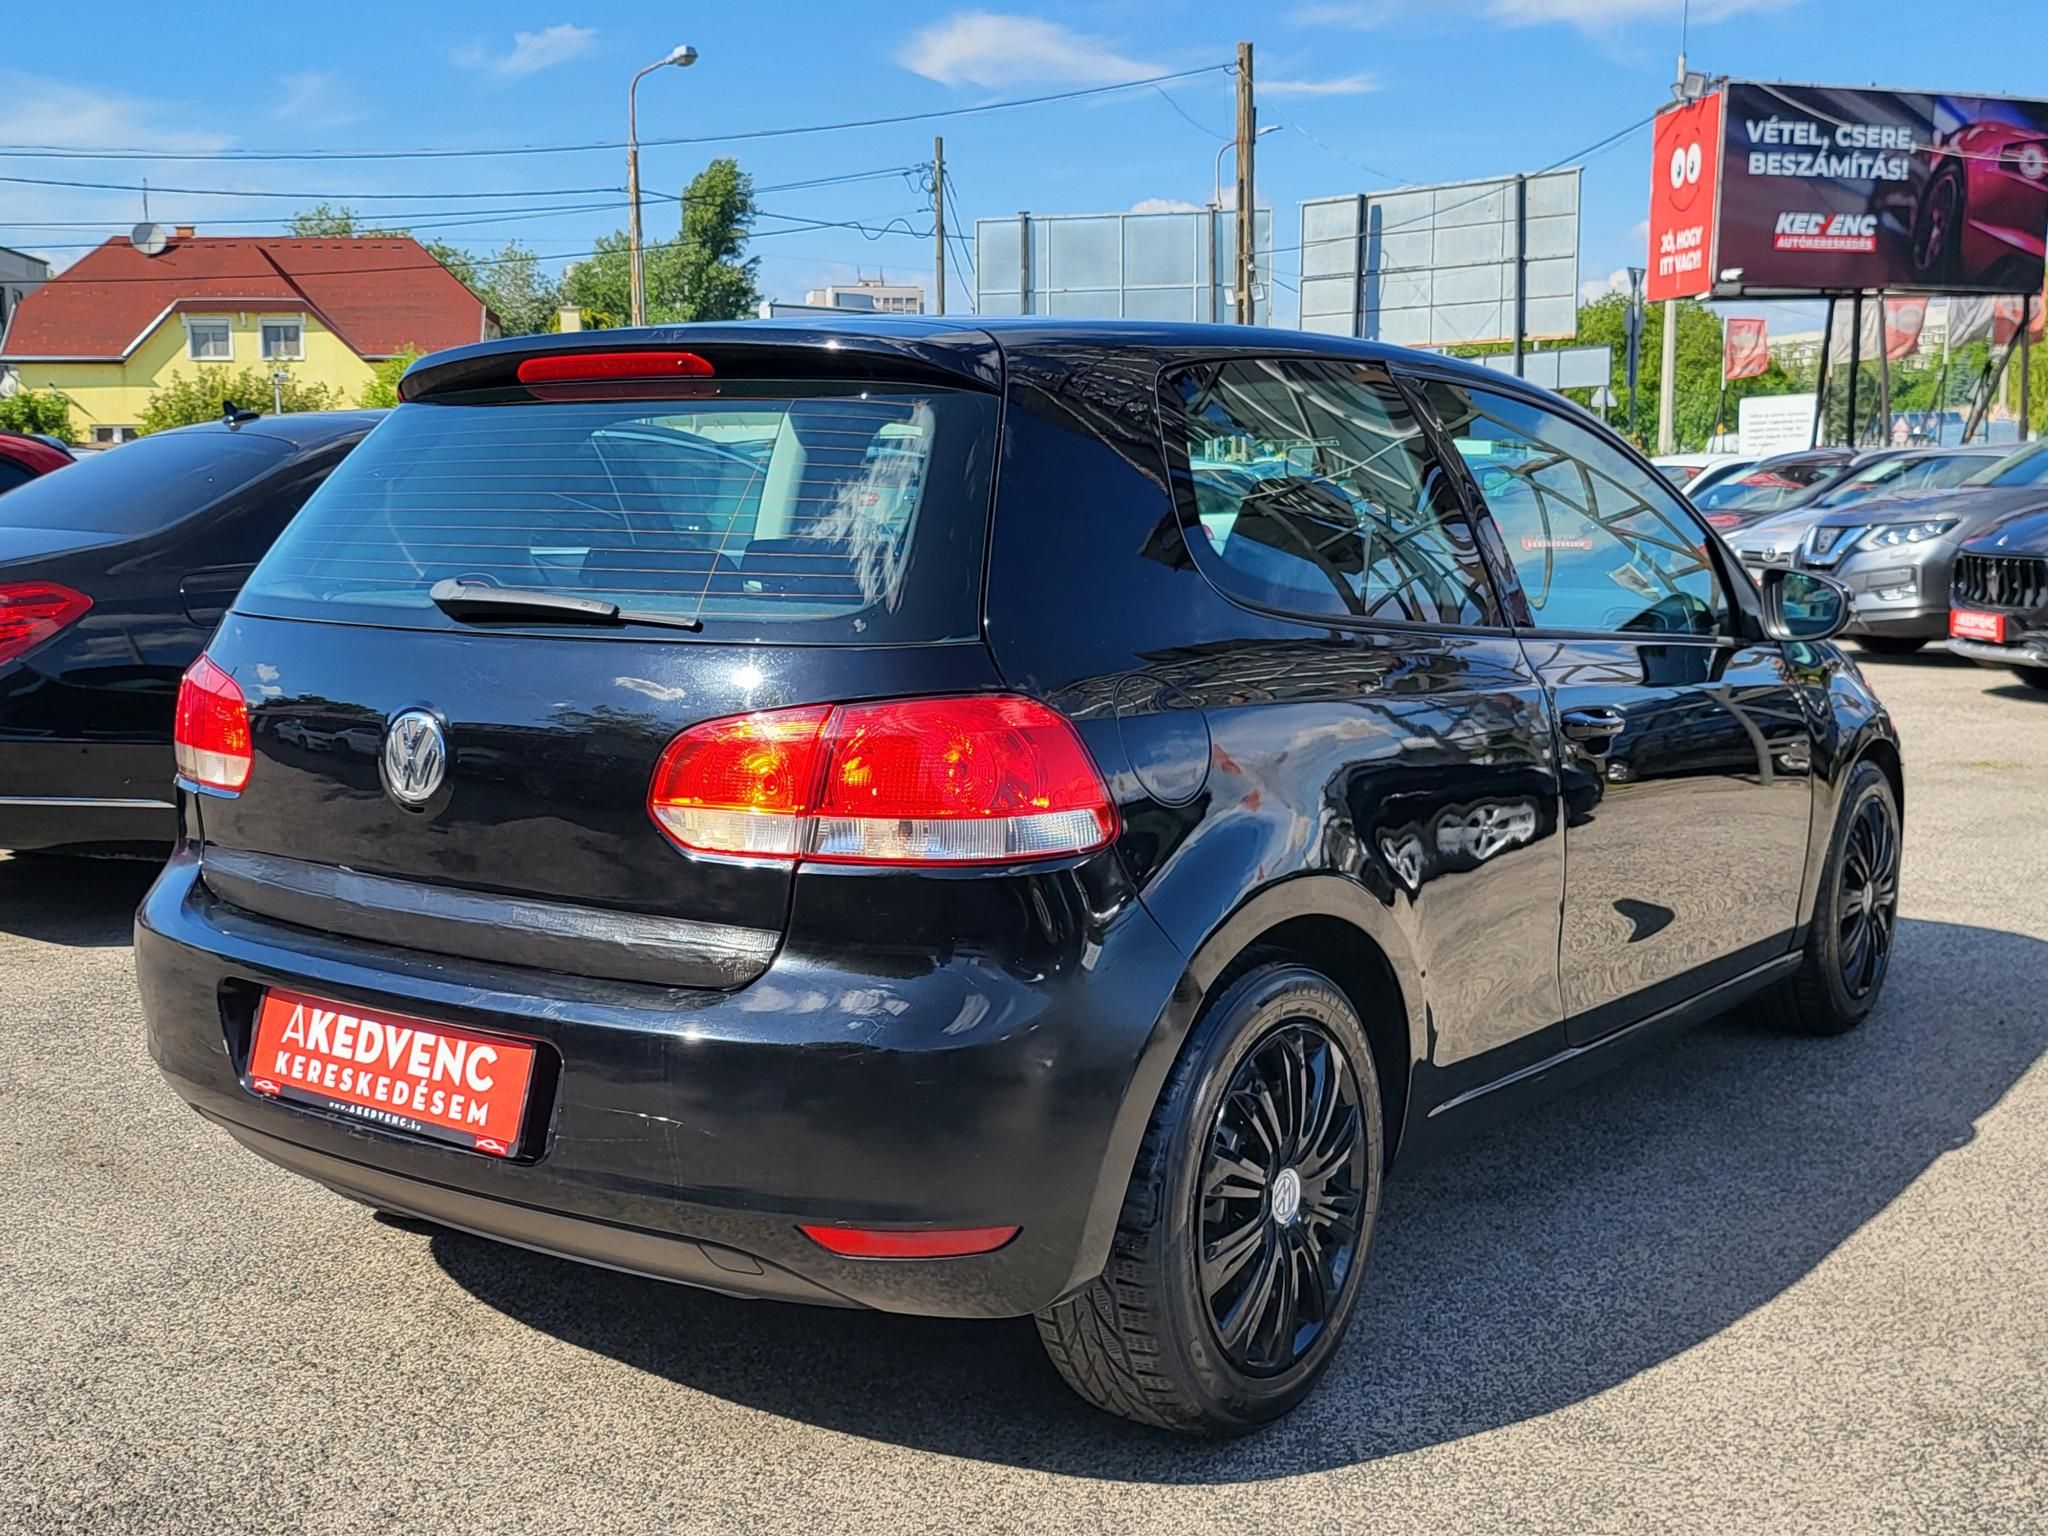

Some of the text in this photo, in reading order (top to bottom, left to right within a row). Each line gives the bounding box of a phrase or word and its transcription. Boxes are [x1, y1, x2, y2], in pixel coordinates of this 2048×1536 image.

[1746, 116, 1918, 154] VÉTEL, CSERE,
[1748, 147, 1909, 181] BESZÁMÍTÁS!
[1676, 225, 1703, 250] HOGY
[274, 1051, 490, 1127] KERESKEDÉSEM
